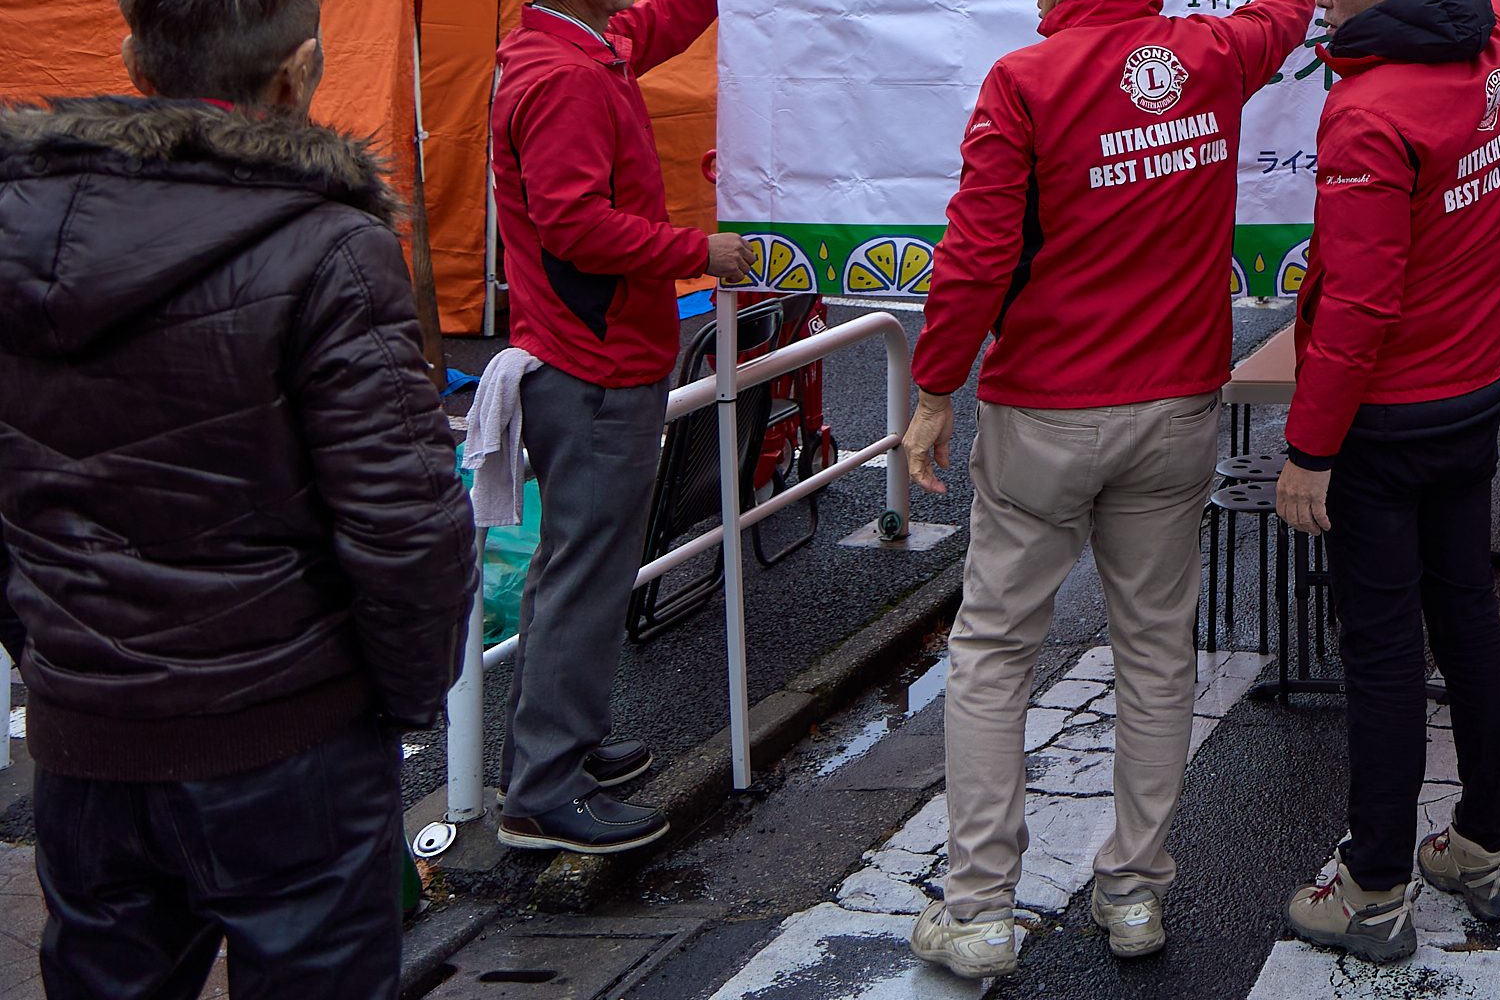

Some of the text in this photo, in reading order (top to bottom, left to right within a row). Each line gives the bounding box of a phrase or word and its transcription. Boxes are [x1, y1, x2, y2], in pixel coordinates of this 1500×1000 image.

[1130, 48, 1170, 66] LIONS
[1145, 67, 1165, 91] L
[1139, 93, 1176, 109] INTERNATIONAL
[1100, 111, 1219, 157] HITACHINAKA
[1089, 139, 1228, 189] BEST LIONS CLUB
[1444, 179, 1480, 213] BEST
